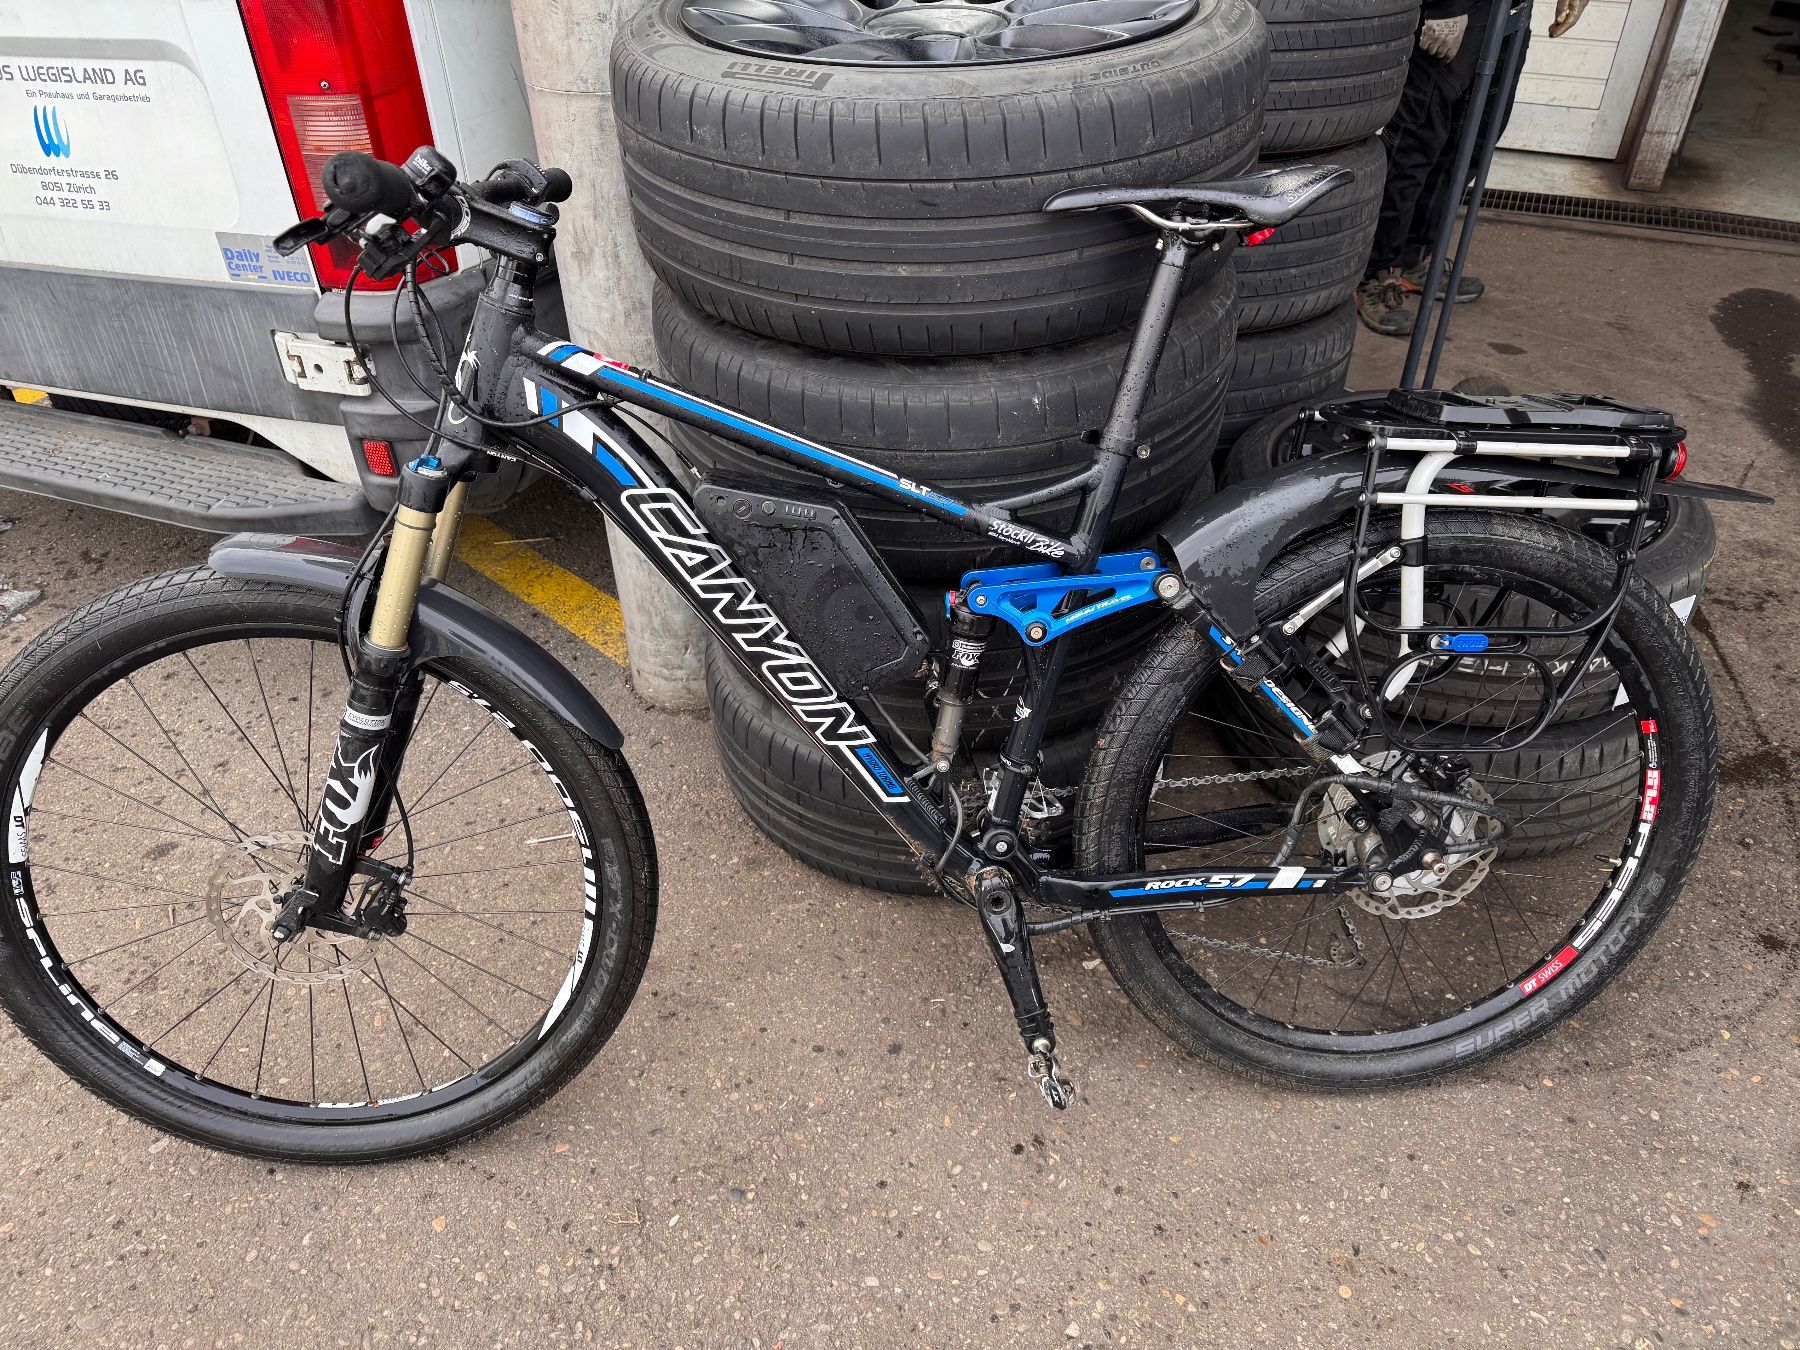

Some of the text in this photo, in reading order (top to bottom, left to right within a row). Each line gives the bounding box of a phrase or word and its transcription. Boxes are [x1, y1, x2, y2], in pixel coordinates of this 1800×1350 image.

[124, 68, 147, 87] AG
[721, 61, 835, 91] PIRELLI
[1089, 59, 1161, 81] OUTSIDE
[25, 90, 151, 103] Ein Pneuhaus und Garagenbetrieb
[10, 163, 119, 180] Dübendorferstrasse 26
[41, 181, 97, 195] 8051 Zürich
[35, 195, 111, 211] 044 322 55 33
[223, 247, 260, 263] Daily
[227, 261, 264, 273] Center
[271, 269, 312, 283] IVECO
[486, 450, 517, 462] CANYON
[898, 478, 932, 497] SLT
[988, 519, 1038, 545] Stöckli
[1025, 537, 1066, 559] Bike
[620, 487, 878, 746] CANYON
[952, 651, 981, 667] FOX
[313, 738, 380, 866] FOX
[13, 815, 25, 829] DT
[17, 831, 27, 859] SWISS
[1144, 873, 1257, 891] ROCK 57
[1455, 902, 1648, 1059] SUPER MOTO-X
[1522, 978, 1538, 994] DT
[1537, 959, 1563, 983] SWISS
